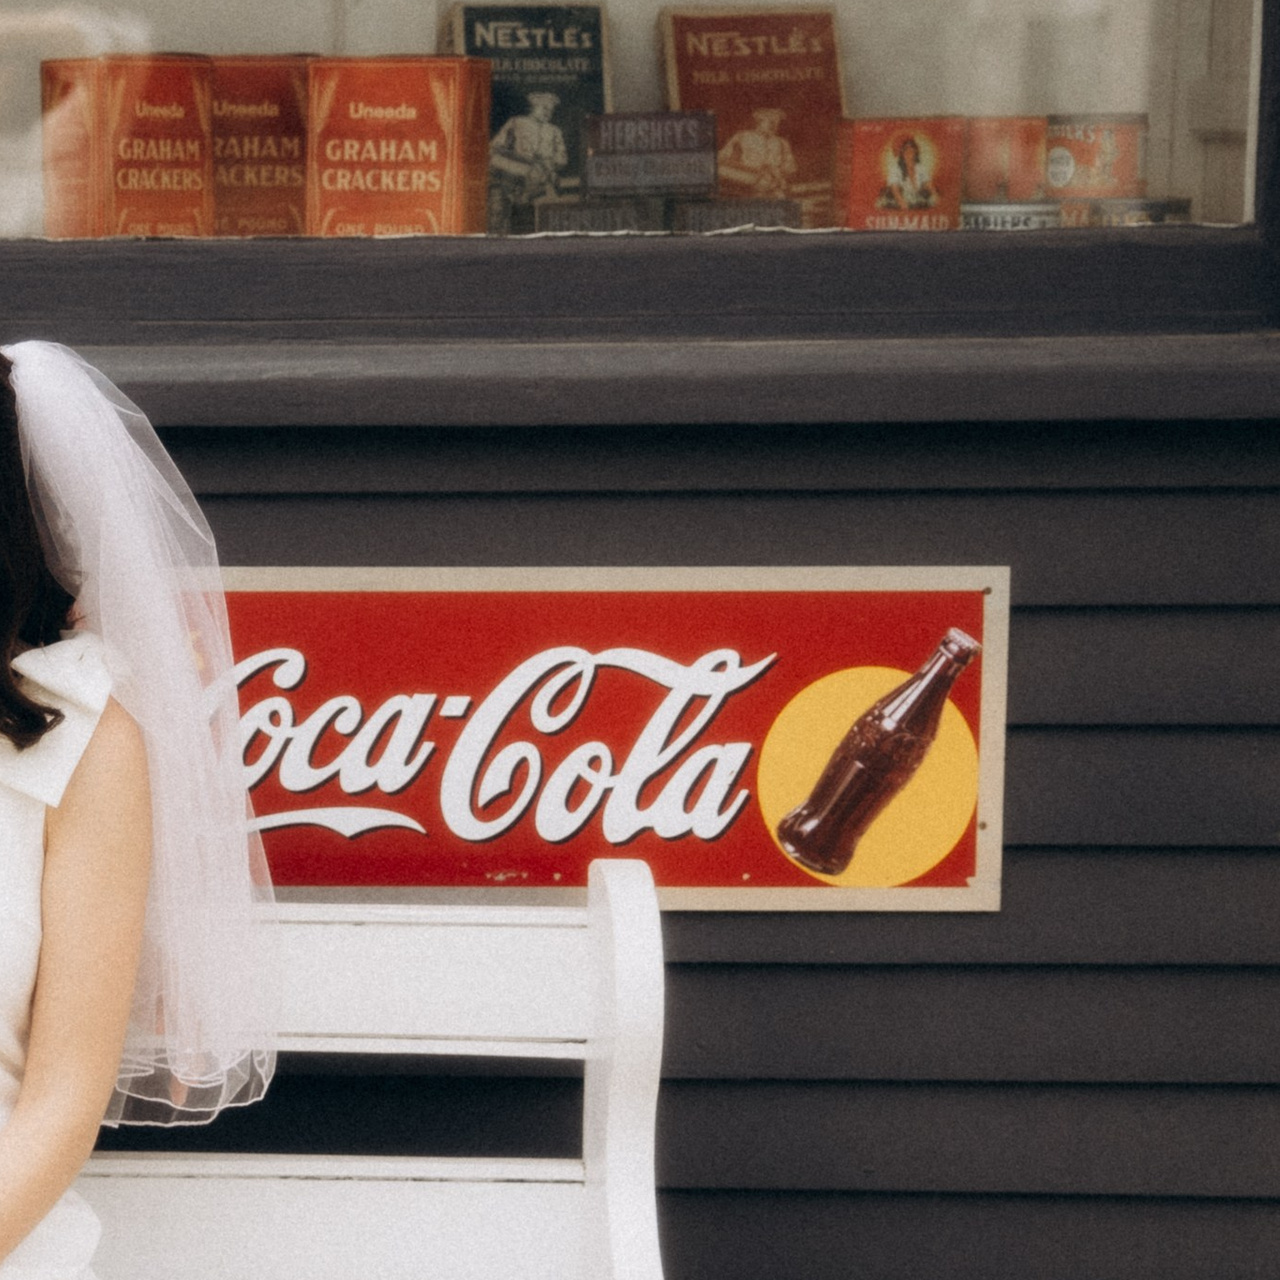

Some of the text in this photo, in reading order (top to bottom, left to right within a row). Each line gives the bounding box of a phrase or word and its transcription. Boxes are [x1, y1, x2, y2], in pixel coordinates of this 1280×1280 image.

[213, 100, 280, 117] Uneeda
[348, 101, 418, 120] Uneeda
[119, 137, 200, 161] GRAHAM
[325, 139, 439, 162] GRAHAM
[116, 168, 203, 191] CRACKERS
[321, 169, 442, 193] CRACKERS
